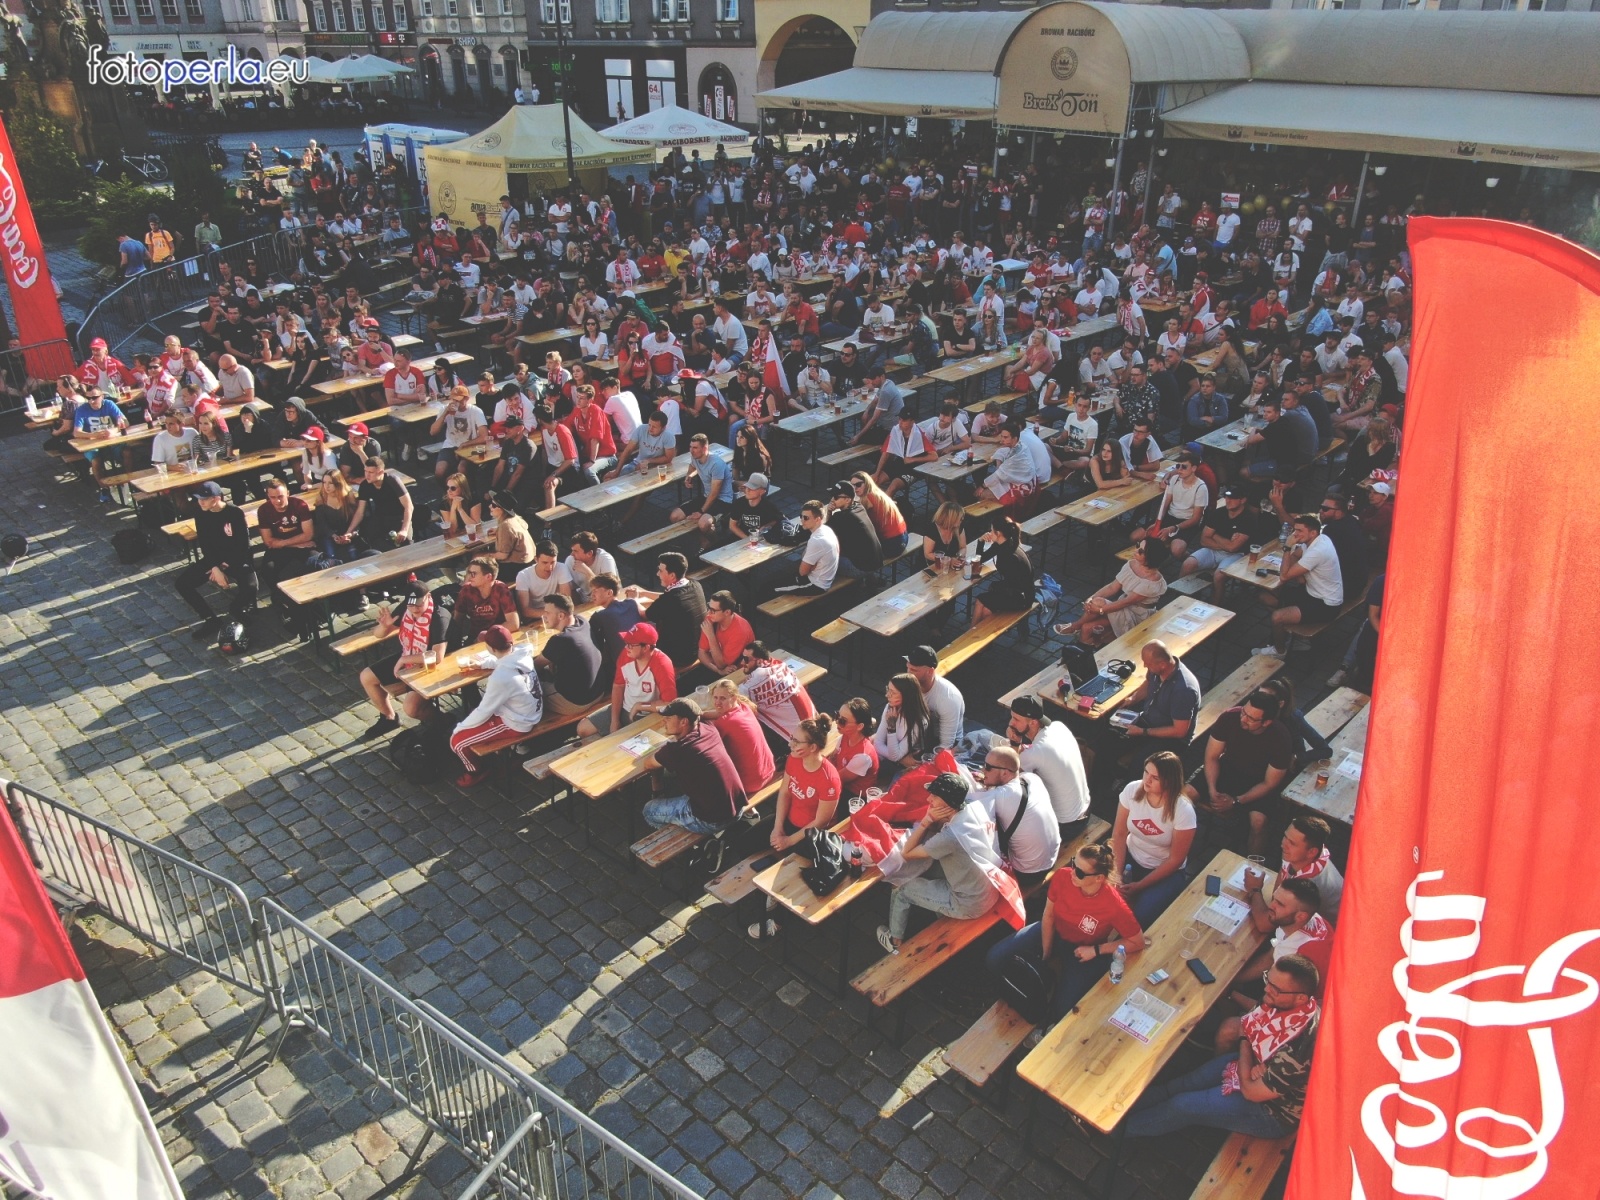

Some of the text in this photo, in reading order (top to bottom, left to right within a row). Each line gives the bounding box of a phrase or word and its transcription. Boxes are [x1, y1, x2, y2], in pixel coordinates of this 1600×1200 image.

[1041, 26, 1095, 37] BROWAR RACIBÓRZ
[662, 136, 710, 146] RACIBORSKIE
